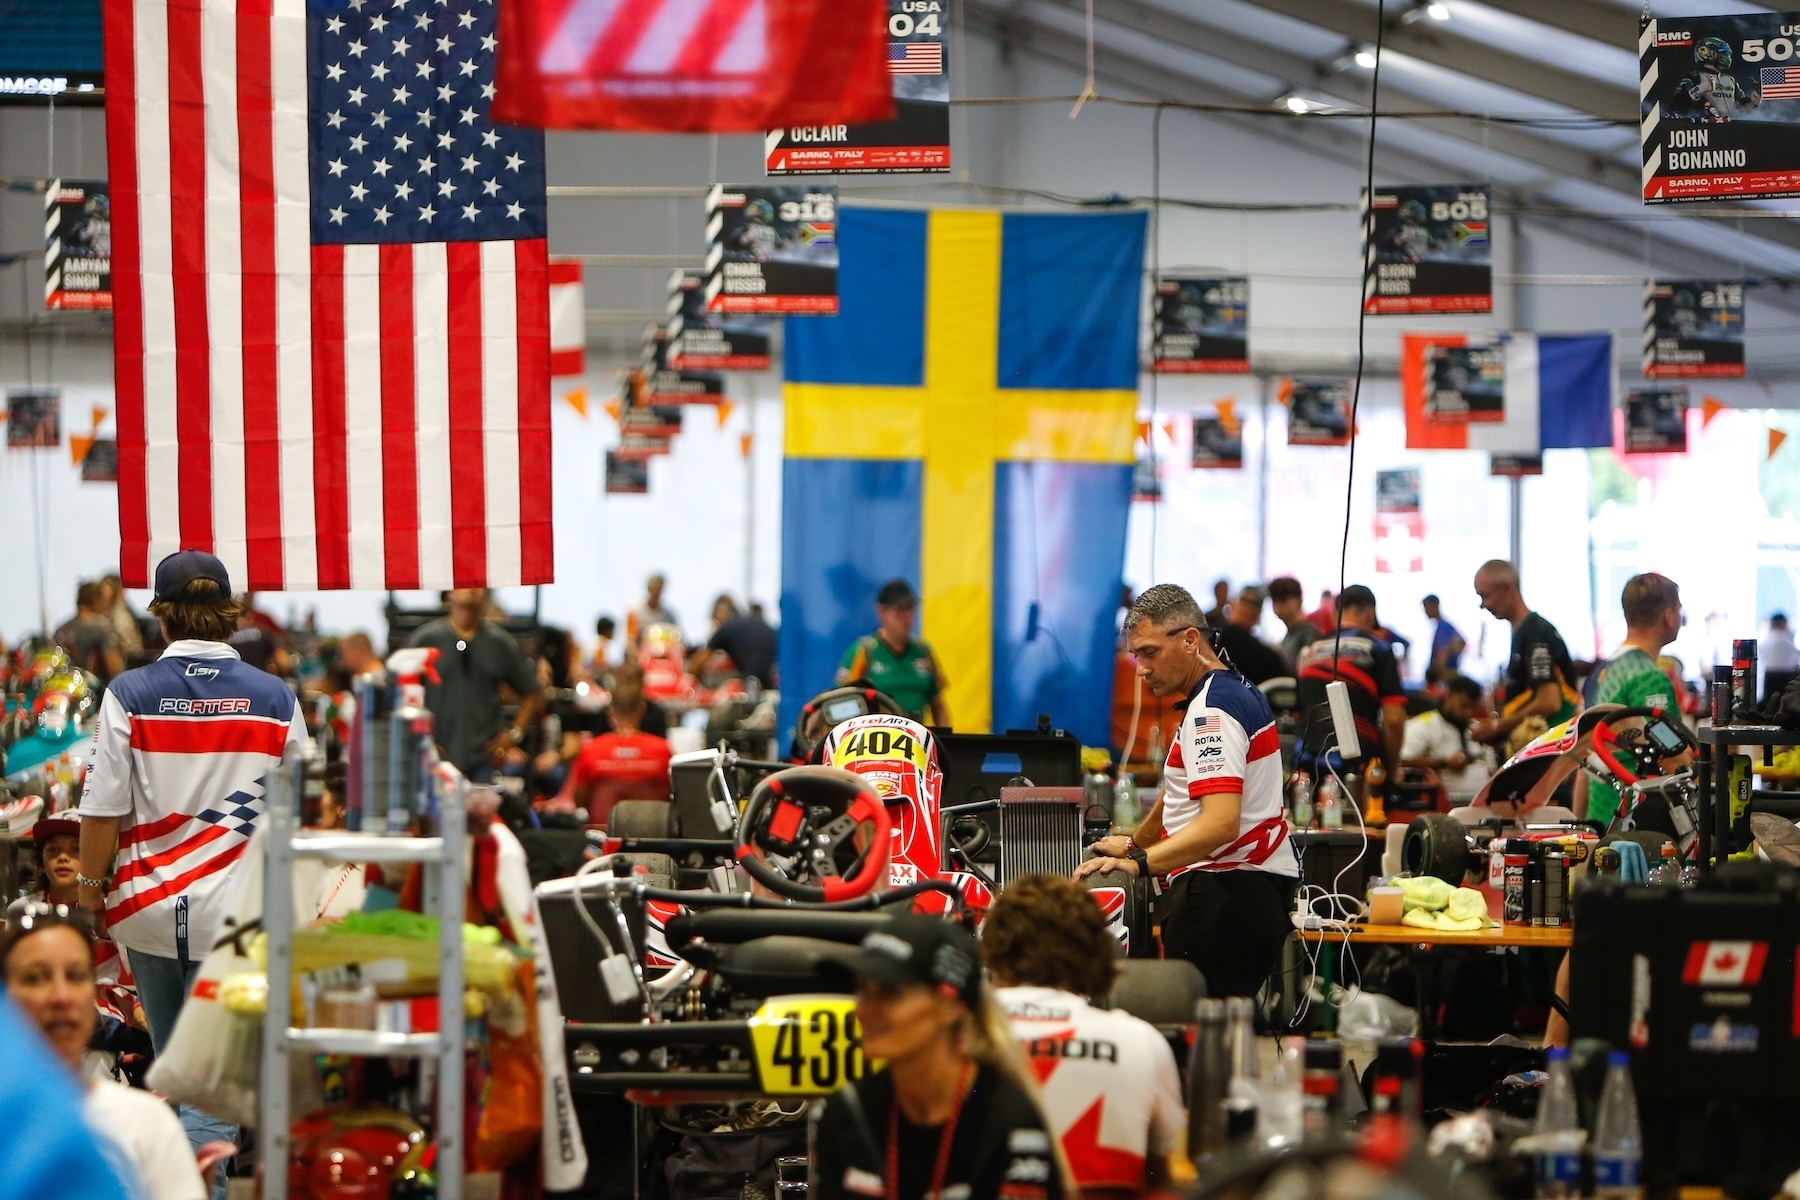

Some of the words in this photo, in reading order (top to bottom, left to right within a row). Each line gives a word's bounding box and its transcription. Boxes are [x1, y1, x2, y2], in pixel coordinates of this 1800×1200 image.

[902, 1, 942, 12] USA
[884, 13, 942, 37] 04
[1658, 31, 1691, 41] RMC
[1741, 37, 1800, 62] 50
[1668, 129, 1708, 148] JOHN
[791, 151, 832, 160] SARNO,
[834, 150, 864, 158] ITALY
[1668, 149, 1746, 170] BONANNO
[1668, 178, 1711, 188] SARNO,
[1713, 176, 1743, 185] ITALY
[779, 201, 835, 222] 316
[1431, 201, 1488, 220] 505
[63, 258, 110, 274] AARYAN
[63, 273, 100, 290] SINGH
[723, 277, 766, 294] VISSER
[159, 698, 251, 713] PORTER
[845, 731, 915, 760] 404
[1195, 735, 1222, 746] ROTAX
[1198, 746, 1223, 758] XPS
[890, 865, 914, 879] AX
[772, 1009, 864, 1088] 438
